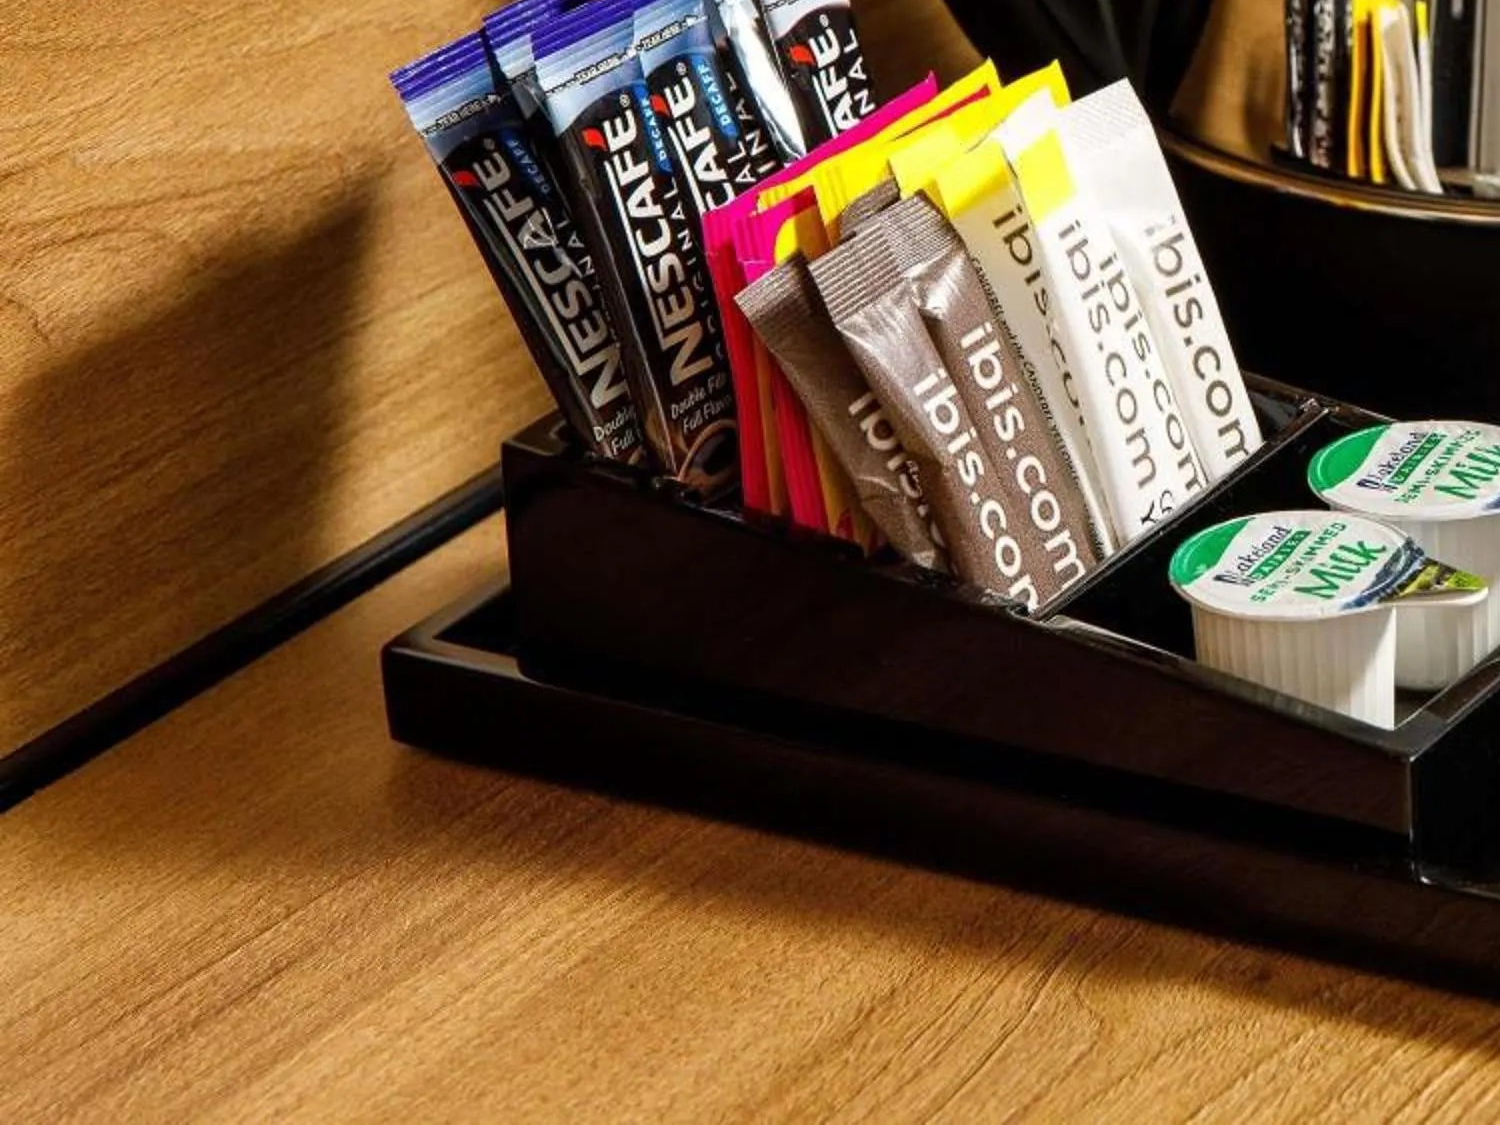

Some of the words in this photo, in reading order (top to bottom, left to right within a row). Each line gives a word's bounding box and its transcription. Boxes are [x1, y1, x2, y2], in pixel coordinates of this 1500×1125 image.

[960, 322, 1086, 591] ibis.com
[1058, 219, 1157, 489] ibis.com
[1294, 540, 1387, 600] Milk
